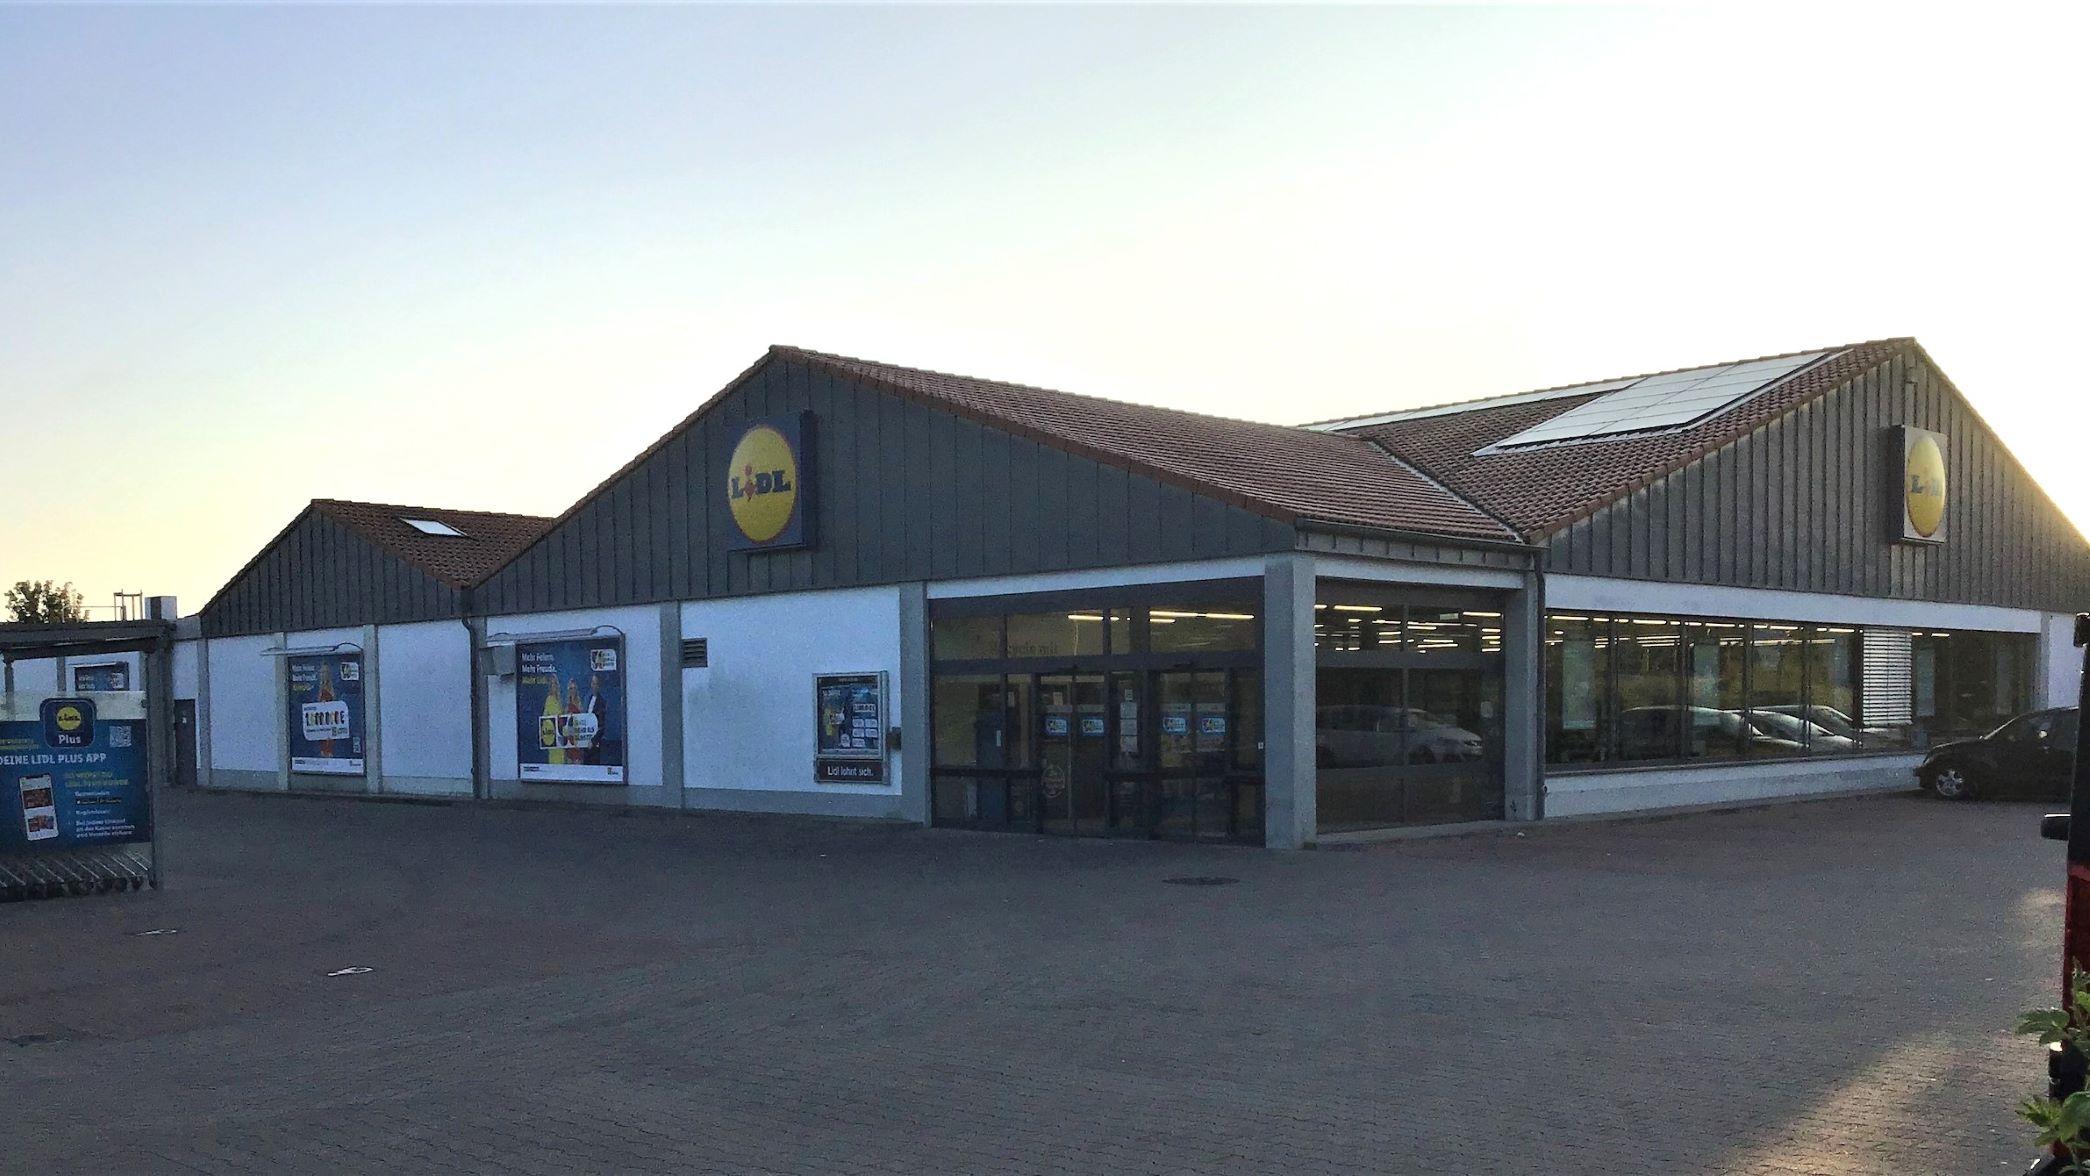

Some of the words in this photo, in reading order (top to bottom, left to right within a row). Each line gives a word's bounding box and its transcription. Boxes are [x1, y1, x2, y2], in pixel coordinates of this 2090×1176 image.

[58, 734, 81, 745] Plus
[31, 754, 56, 765] LIDL
[58, 754, 83, 764] PLUS
[86, 752, 107, 763] APP
[840, 766, 857, 776] lohnt
